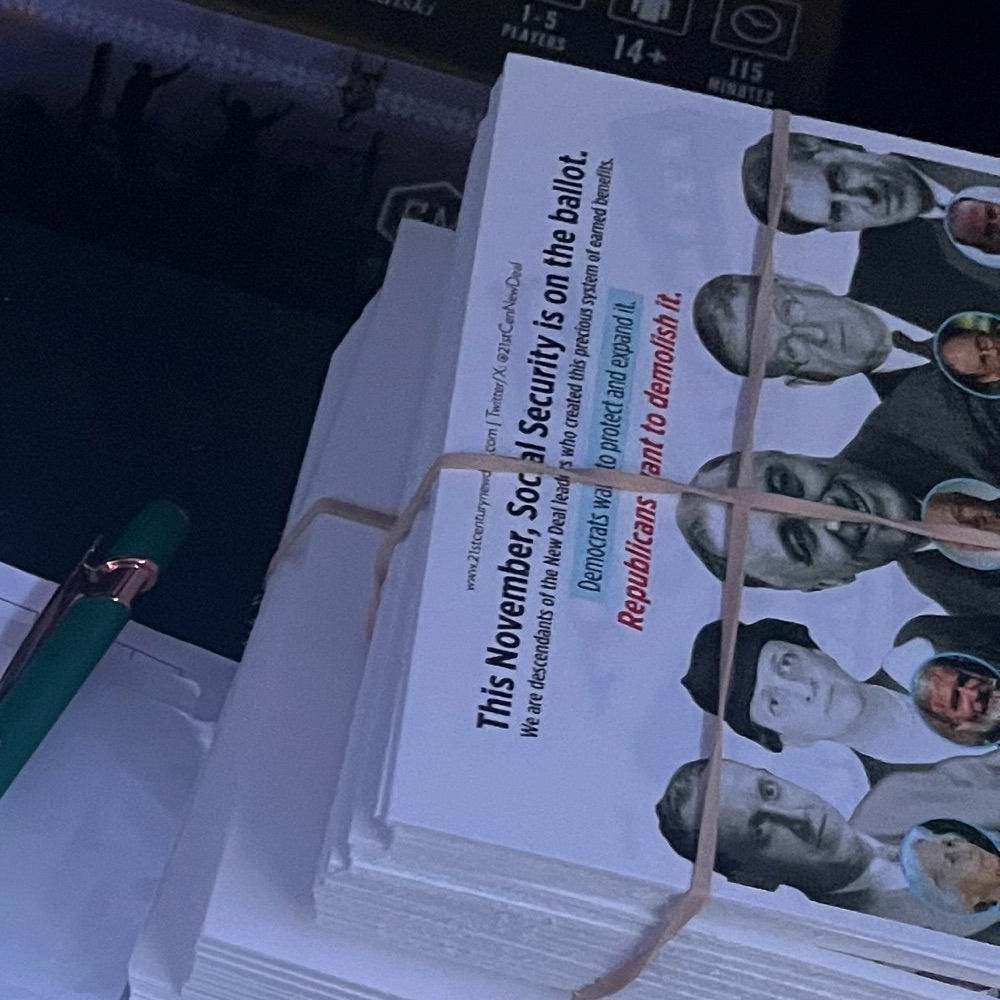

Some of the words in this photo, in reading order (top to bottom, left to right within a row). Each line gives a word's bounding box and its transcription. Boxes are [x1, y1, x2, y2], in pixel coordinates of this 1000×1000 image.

[522, 4, 559, 30] 1-5
[501, 23, 567, 51] PLAYERS
[613, 34, 668, 64] 14+
[729, 56, 764, 83] 115
[707, 77, 774, 105] MINUTES
[547, 150, 589, 225] ballot.
[591, 158, 614, 206] benefits.
[589, 206, 607, 248] earned
[541, 229, 576, 269] the
[585, 248, 601, 263] of
[543, 273, 570, 305] on
[581, 264, 599, 306] system
[612, 300, 637, 315] it.
[655, 292, 682, 313] it.
[532, 309, 565, 331] is
[574, 307, 593, 358] precious
[610, 314, 635, 369] expand
[568, 358, 586, 381] this
[643, 314, 679, 410] demolish
[518, 334, 566, 439] Security
[604, 369, 627, 400] and
[564, 382, 583, 429] created
[599, 400, 624, 454] protect
[639, 412, 667, 436] to
[558, 430, 578, 457] who
[639, 437, 665, 476] ant
[594, 454, 617, 470] to
[506, 440, 546, 522] Socal
[547, 506, 567, 536] Deal
[542, 537, 563, 567] New
[576, 512, 610, 593] Democrats
[617, 495, 657, 631] Republicans
[540, 569, 559, 591] the
[484, 529, 542, 671] November,
[538, 591, 556, 607] of
[526, 609, 554, 690] descendants
[475, 674, 515, 730] This
[527, 692, 544, 715] are
[519, 716, 541, 738] We
